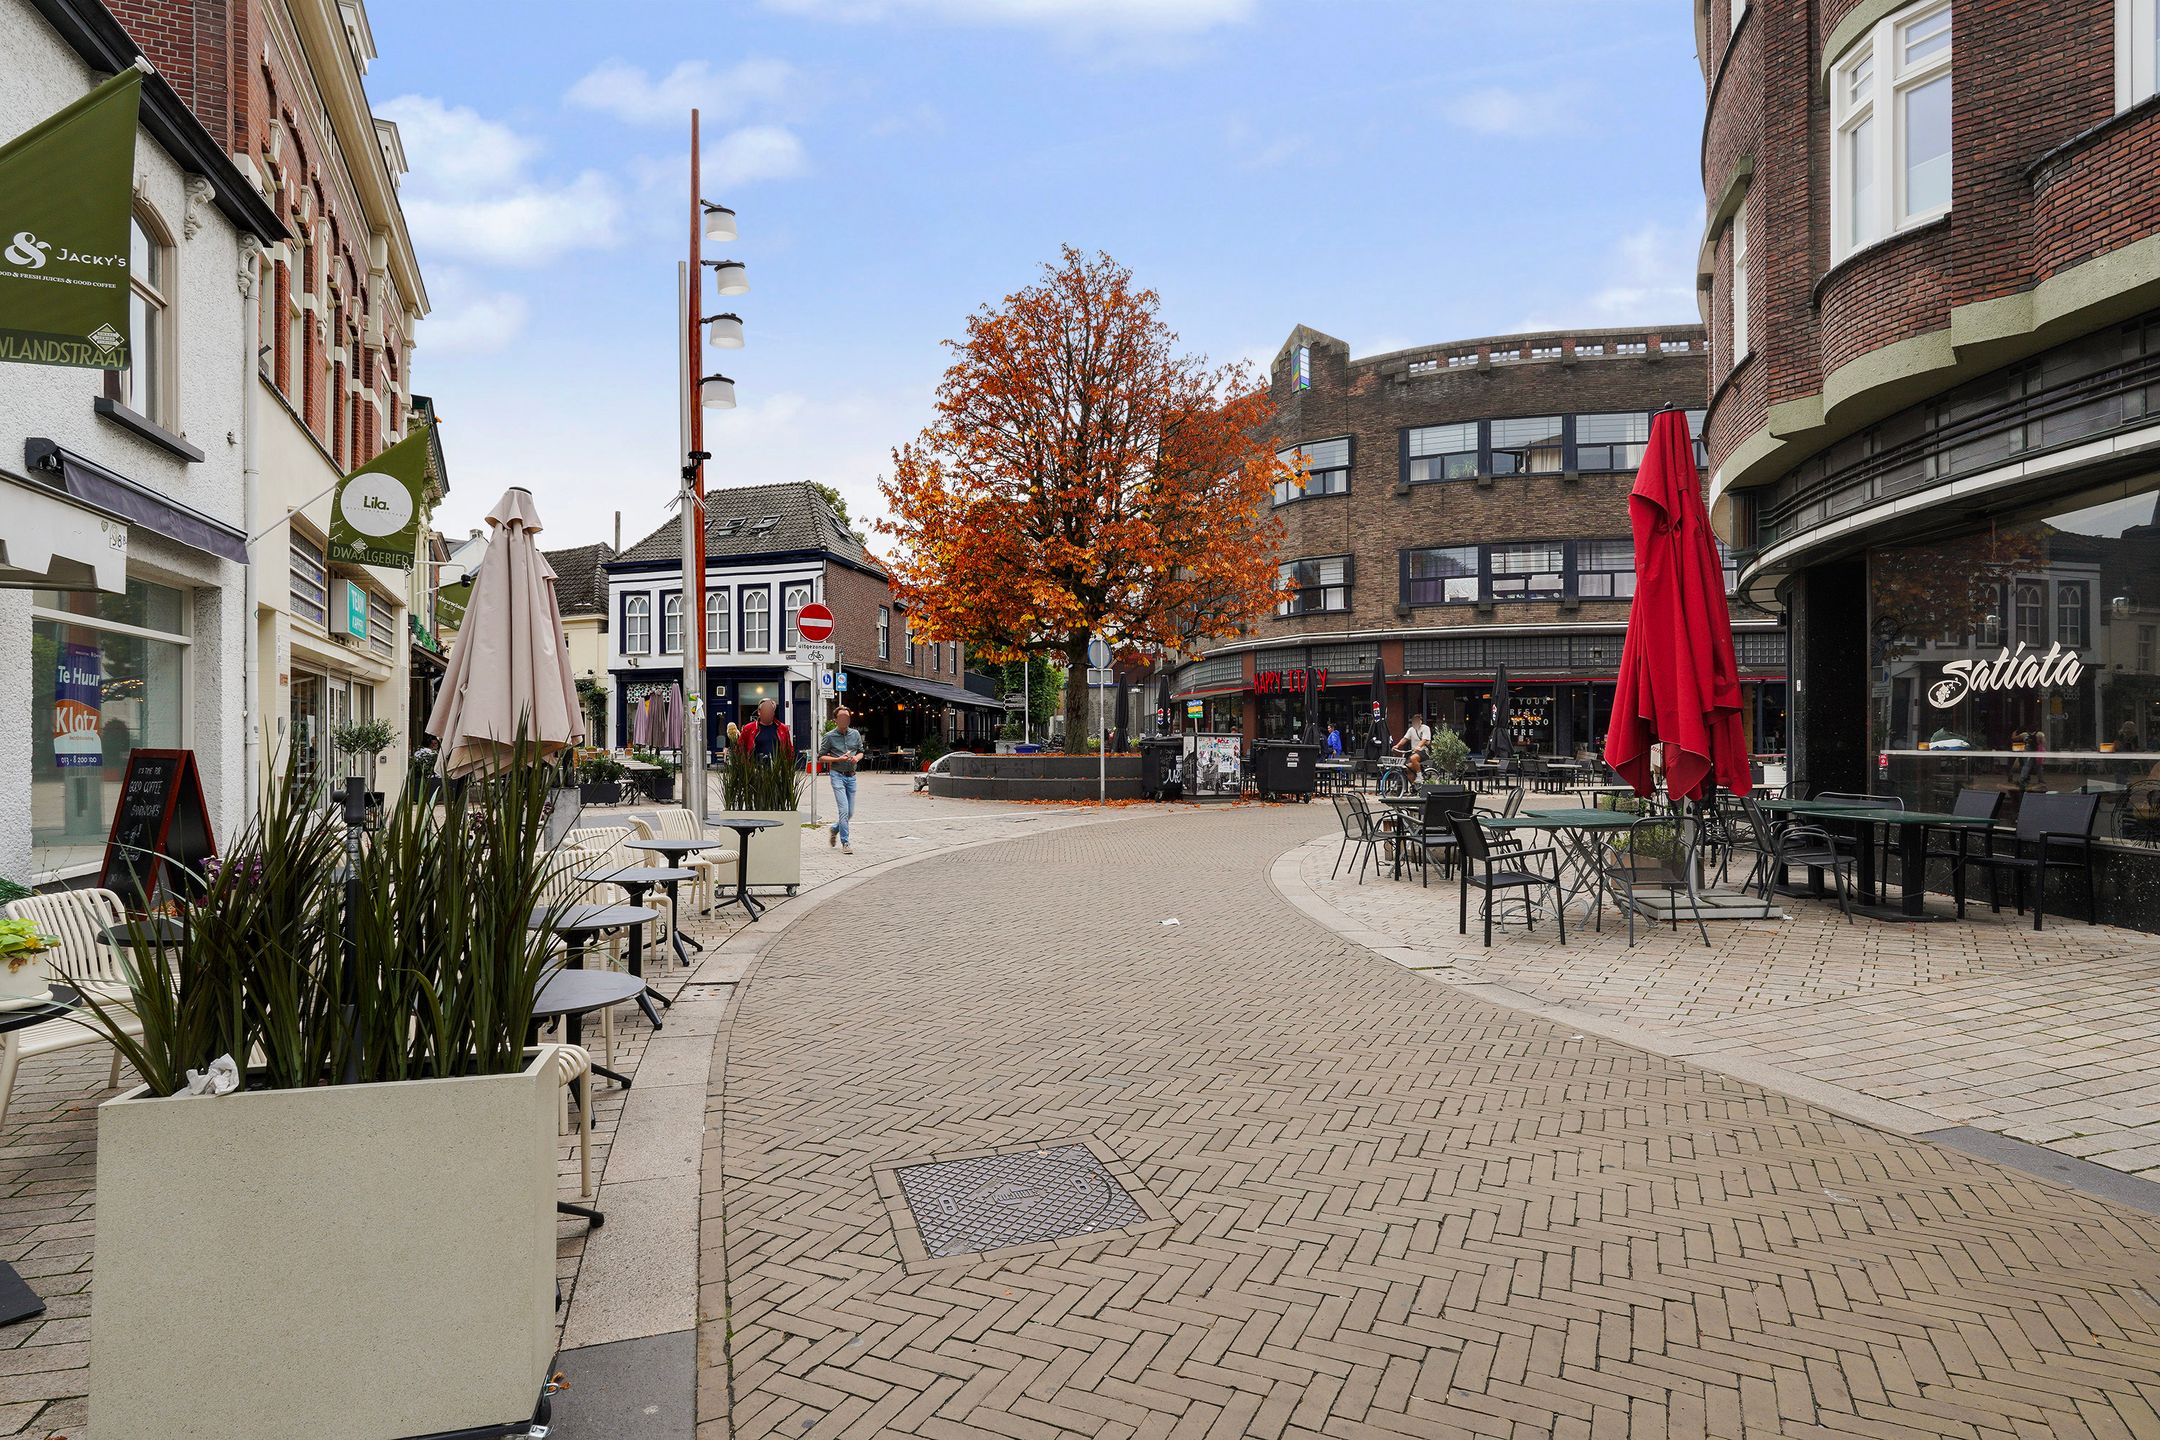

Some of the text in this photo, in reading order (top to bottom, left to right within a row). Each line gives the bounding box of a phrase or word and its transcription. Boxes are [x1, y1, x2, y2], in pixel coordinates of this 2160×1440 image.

[20, 273, 42, 281] FRESH
[42, 275, 66, 283] JUICES
[92, 281, 117, 289] COFFEE
[333, 546, 409, 566] DWAALGEBIED
[58, 665, 100, 687] Te Huur
[1253, 668, 1328, 695] HAPPY ITY
[1519, 697, 1548, 705] YOUR
[56, 706, 98, 733] Klotz
[143, 780, 164, 795] COFFEE
